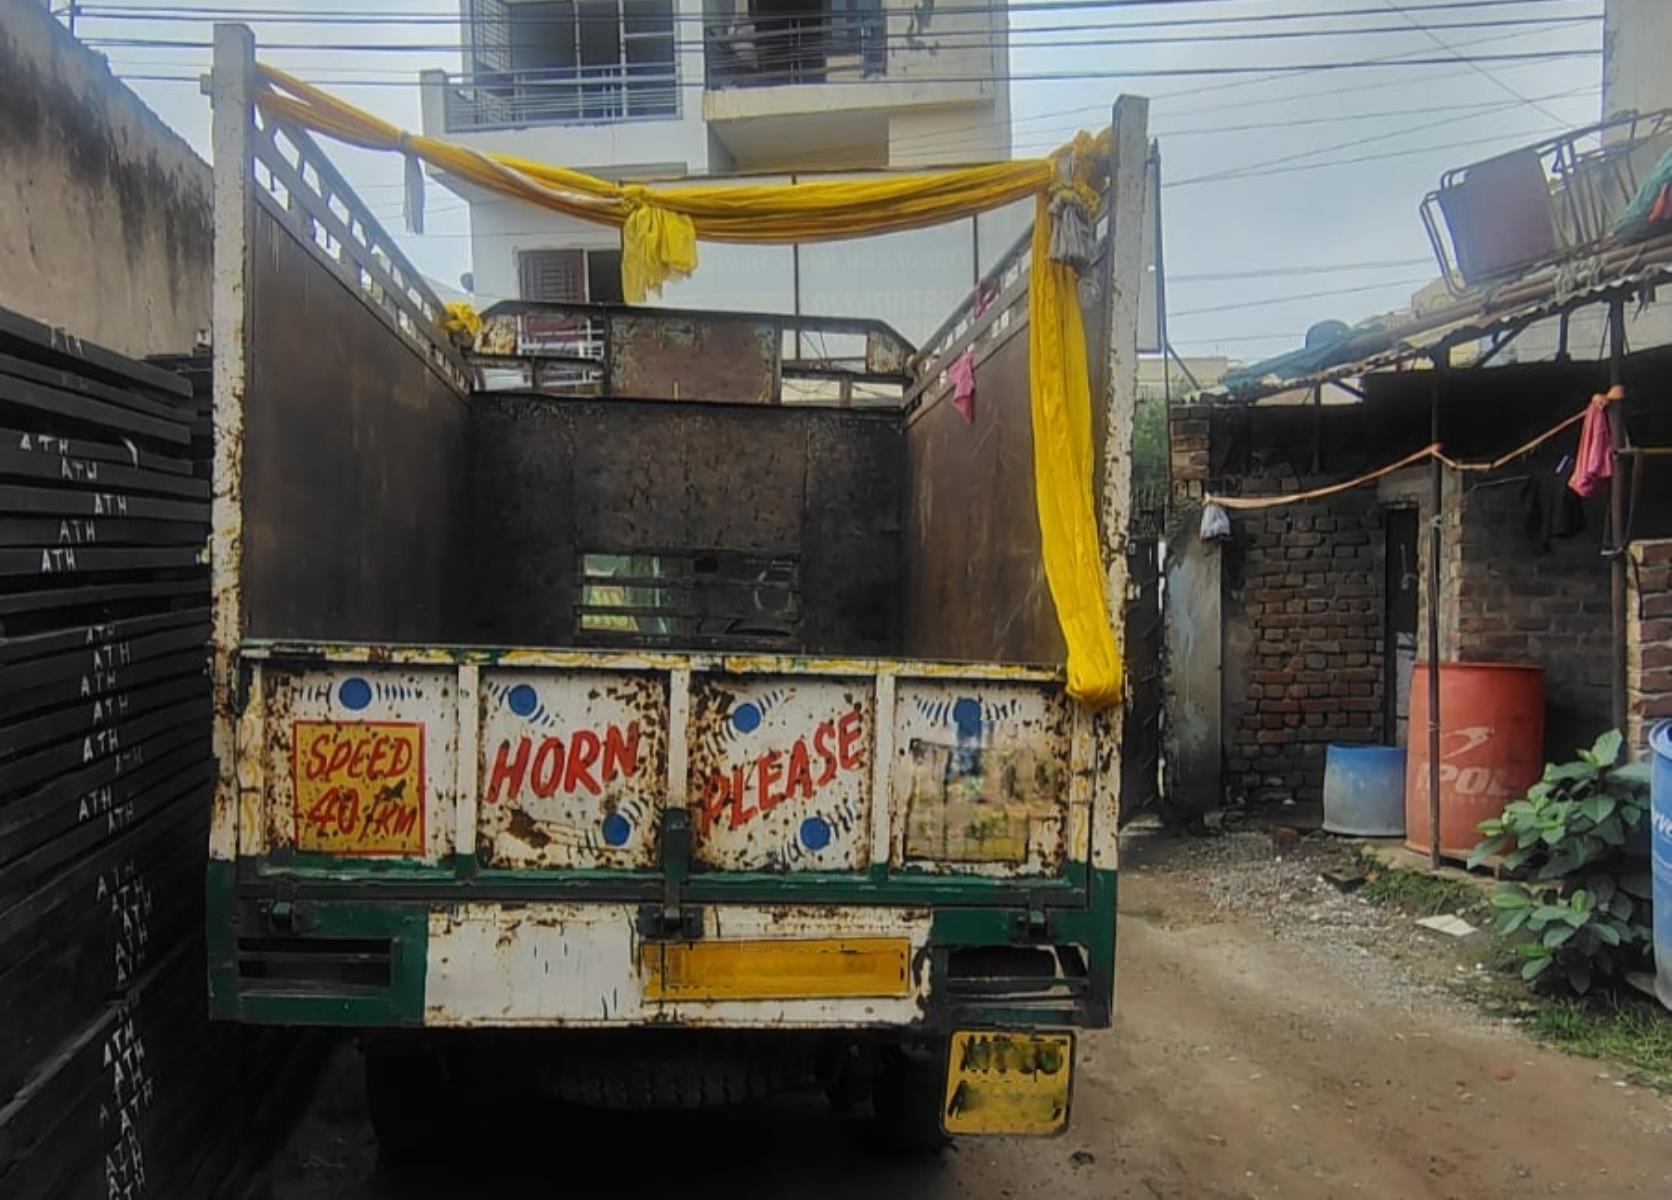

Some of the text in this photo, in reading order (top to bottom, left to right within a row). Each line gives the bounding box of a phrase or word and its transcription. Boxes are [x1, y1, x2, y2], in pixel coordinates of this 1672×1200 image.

[20, 433, 69, 454] ATH
[94, 493, 127, 515] ATH
[58, 519, 96, 543] ATH
[41, 549, 76, 573] ATH
[94, 642, 130, 671] ATH
[80, 671, 115, 698] ATH
[92, 694, 129, 725] ATH
[82, 728, 119, 764] ATH
[305, 733, 413, 783] SPEED
[486, 720, 640, 804] HORN
[699, 707, 867, 838] PLEASE
[78, 785, 112, 823] ATH
[307, 787, 360, 835] 40
[103, 1018, 134, 1068] ATH
